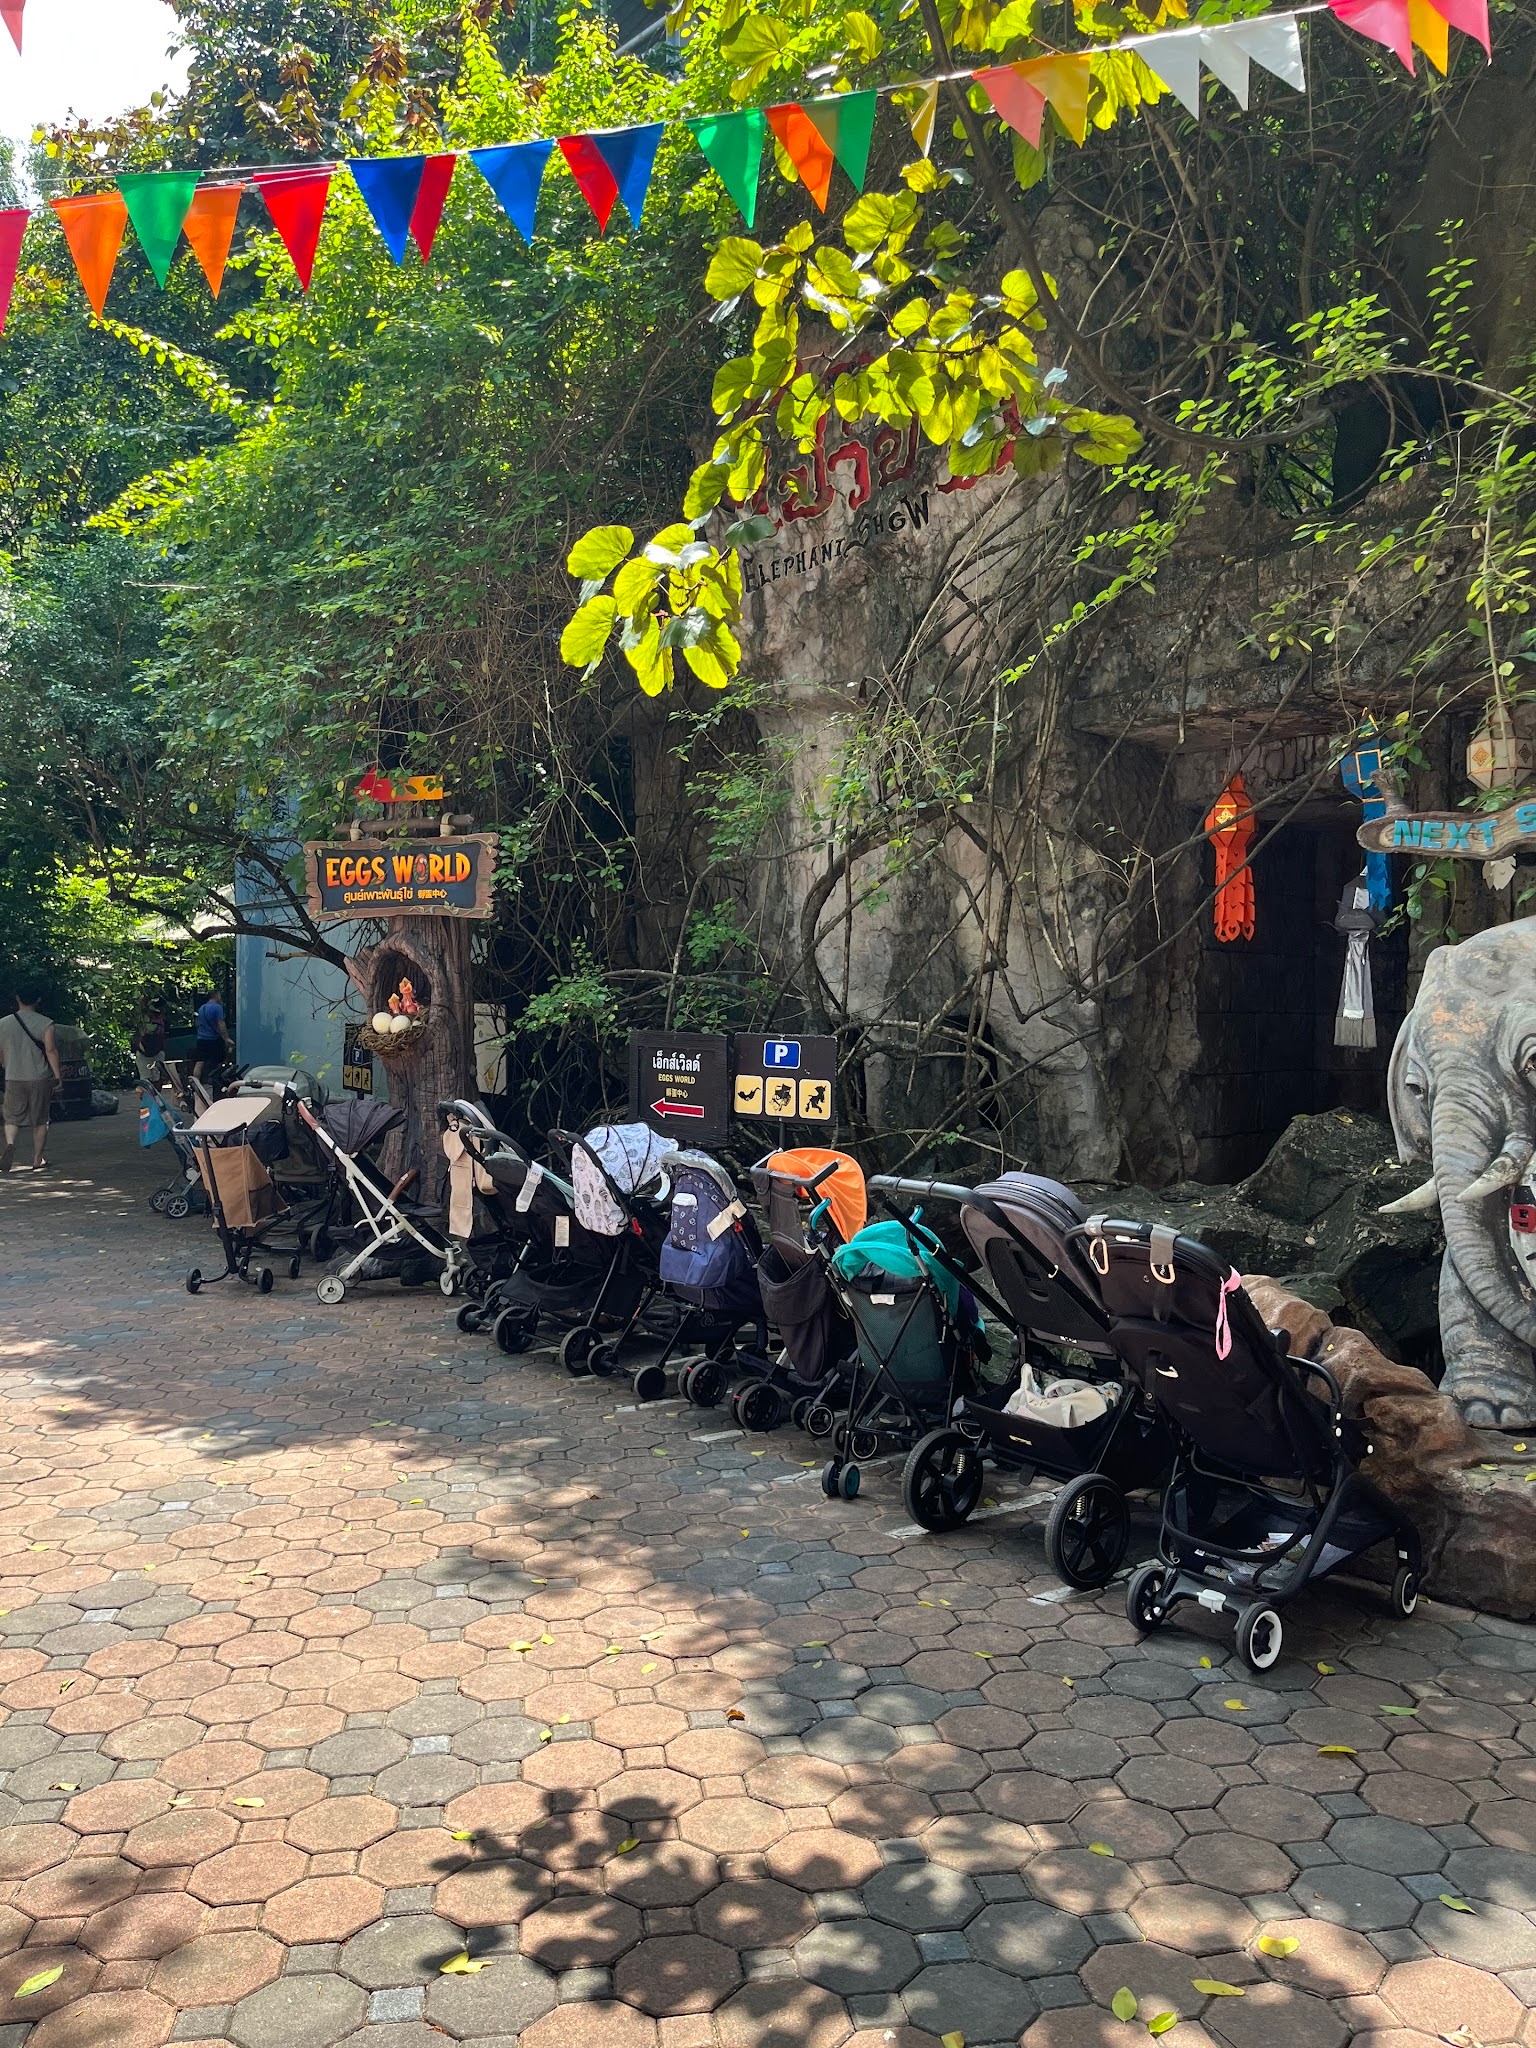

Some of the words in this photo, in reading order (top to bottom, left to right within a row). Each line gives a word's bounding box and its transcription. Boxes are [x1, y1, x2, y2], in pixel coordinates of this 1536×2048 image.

[1392, 819, 1498, 849] NEXT
[326, 856, 386, 887] EGGS
[392, 852, 471, 885] WORLD
[652, 1050, 702, 1073] เอ็กส์เวิลด์
[774, 1044, 789, 1064] P
[658, 1073, 674, 1083] EGGS
[675, 1075, 696, 1085] WORLD
